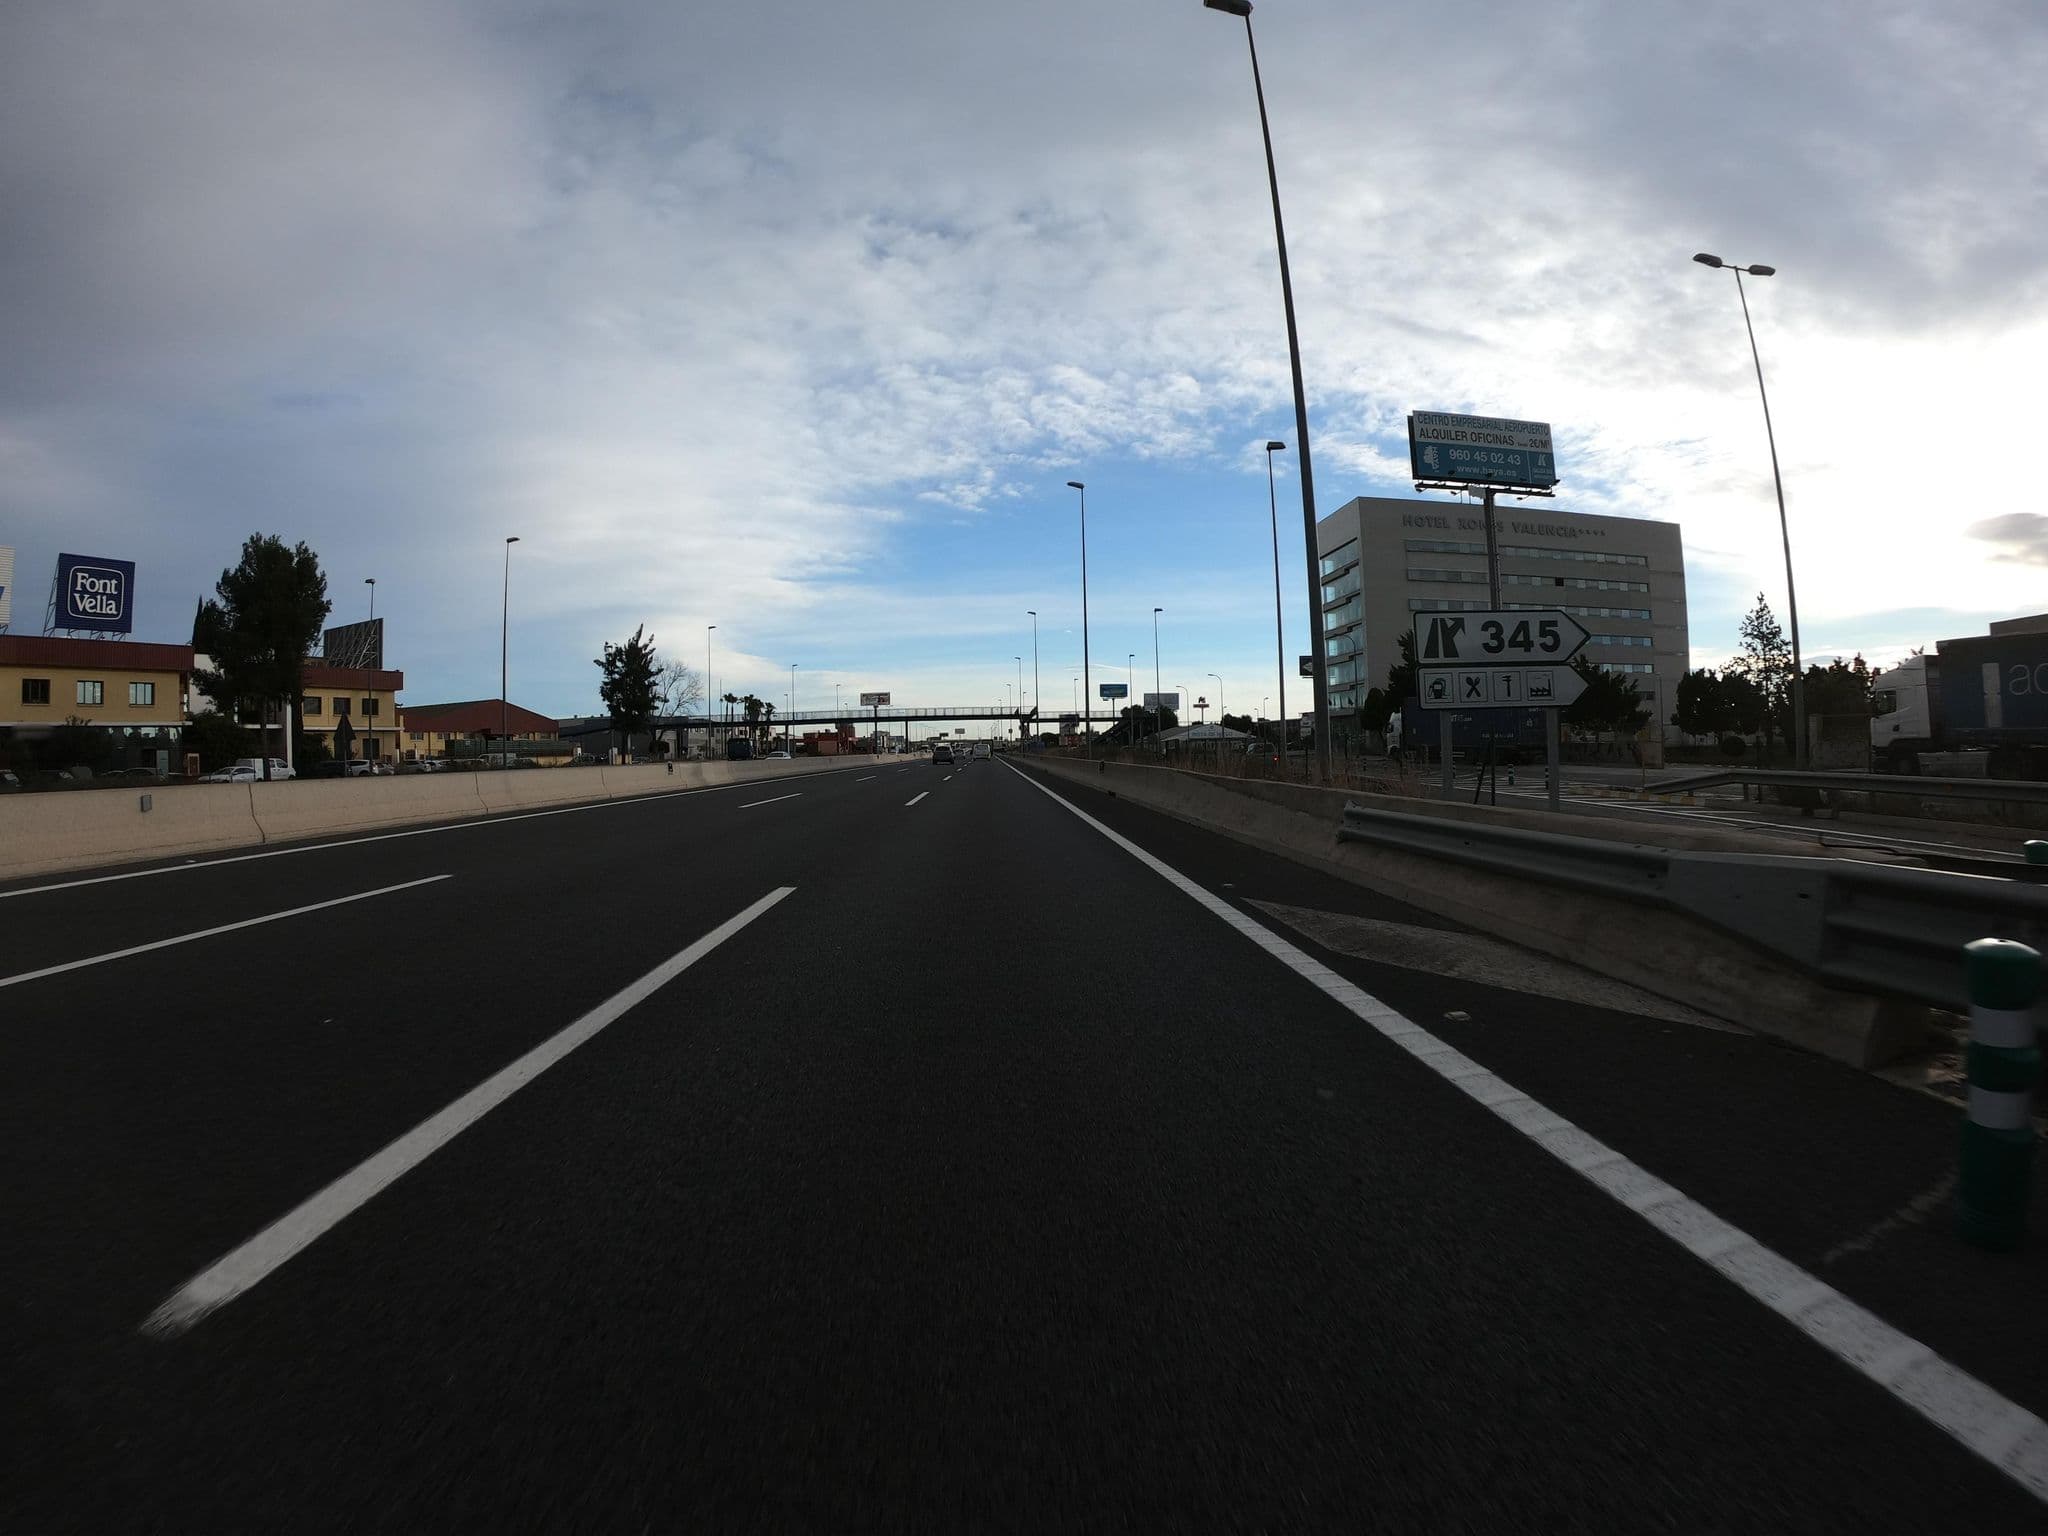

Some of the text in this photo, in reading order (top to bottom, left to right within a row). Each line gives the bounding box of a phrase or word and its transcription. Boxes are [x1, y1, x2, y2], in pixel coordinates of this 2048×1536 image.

[1417, 414, 1549, 436] CENTRO EMPRESARIAL AEROPUERTO
[1419, 428, 1514, 446] ALQUILER OFICINAS
[1449, 448, 1521, 466] 960 45 02 43
[1402, 514, 1450, 529] HOTEL
[75, 572, 118, 594] Font
[73, 593, 118, 615] Vella
[1480, 619, 1561, 654] 345
